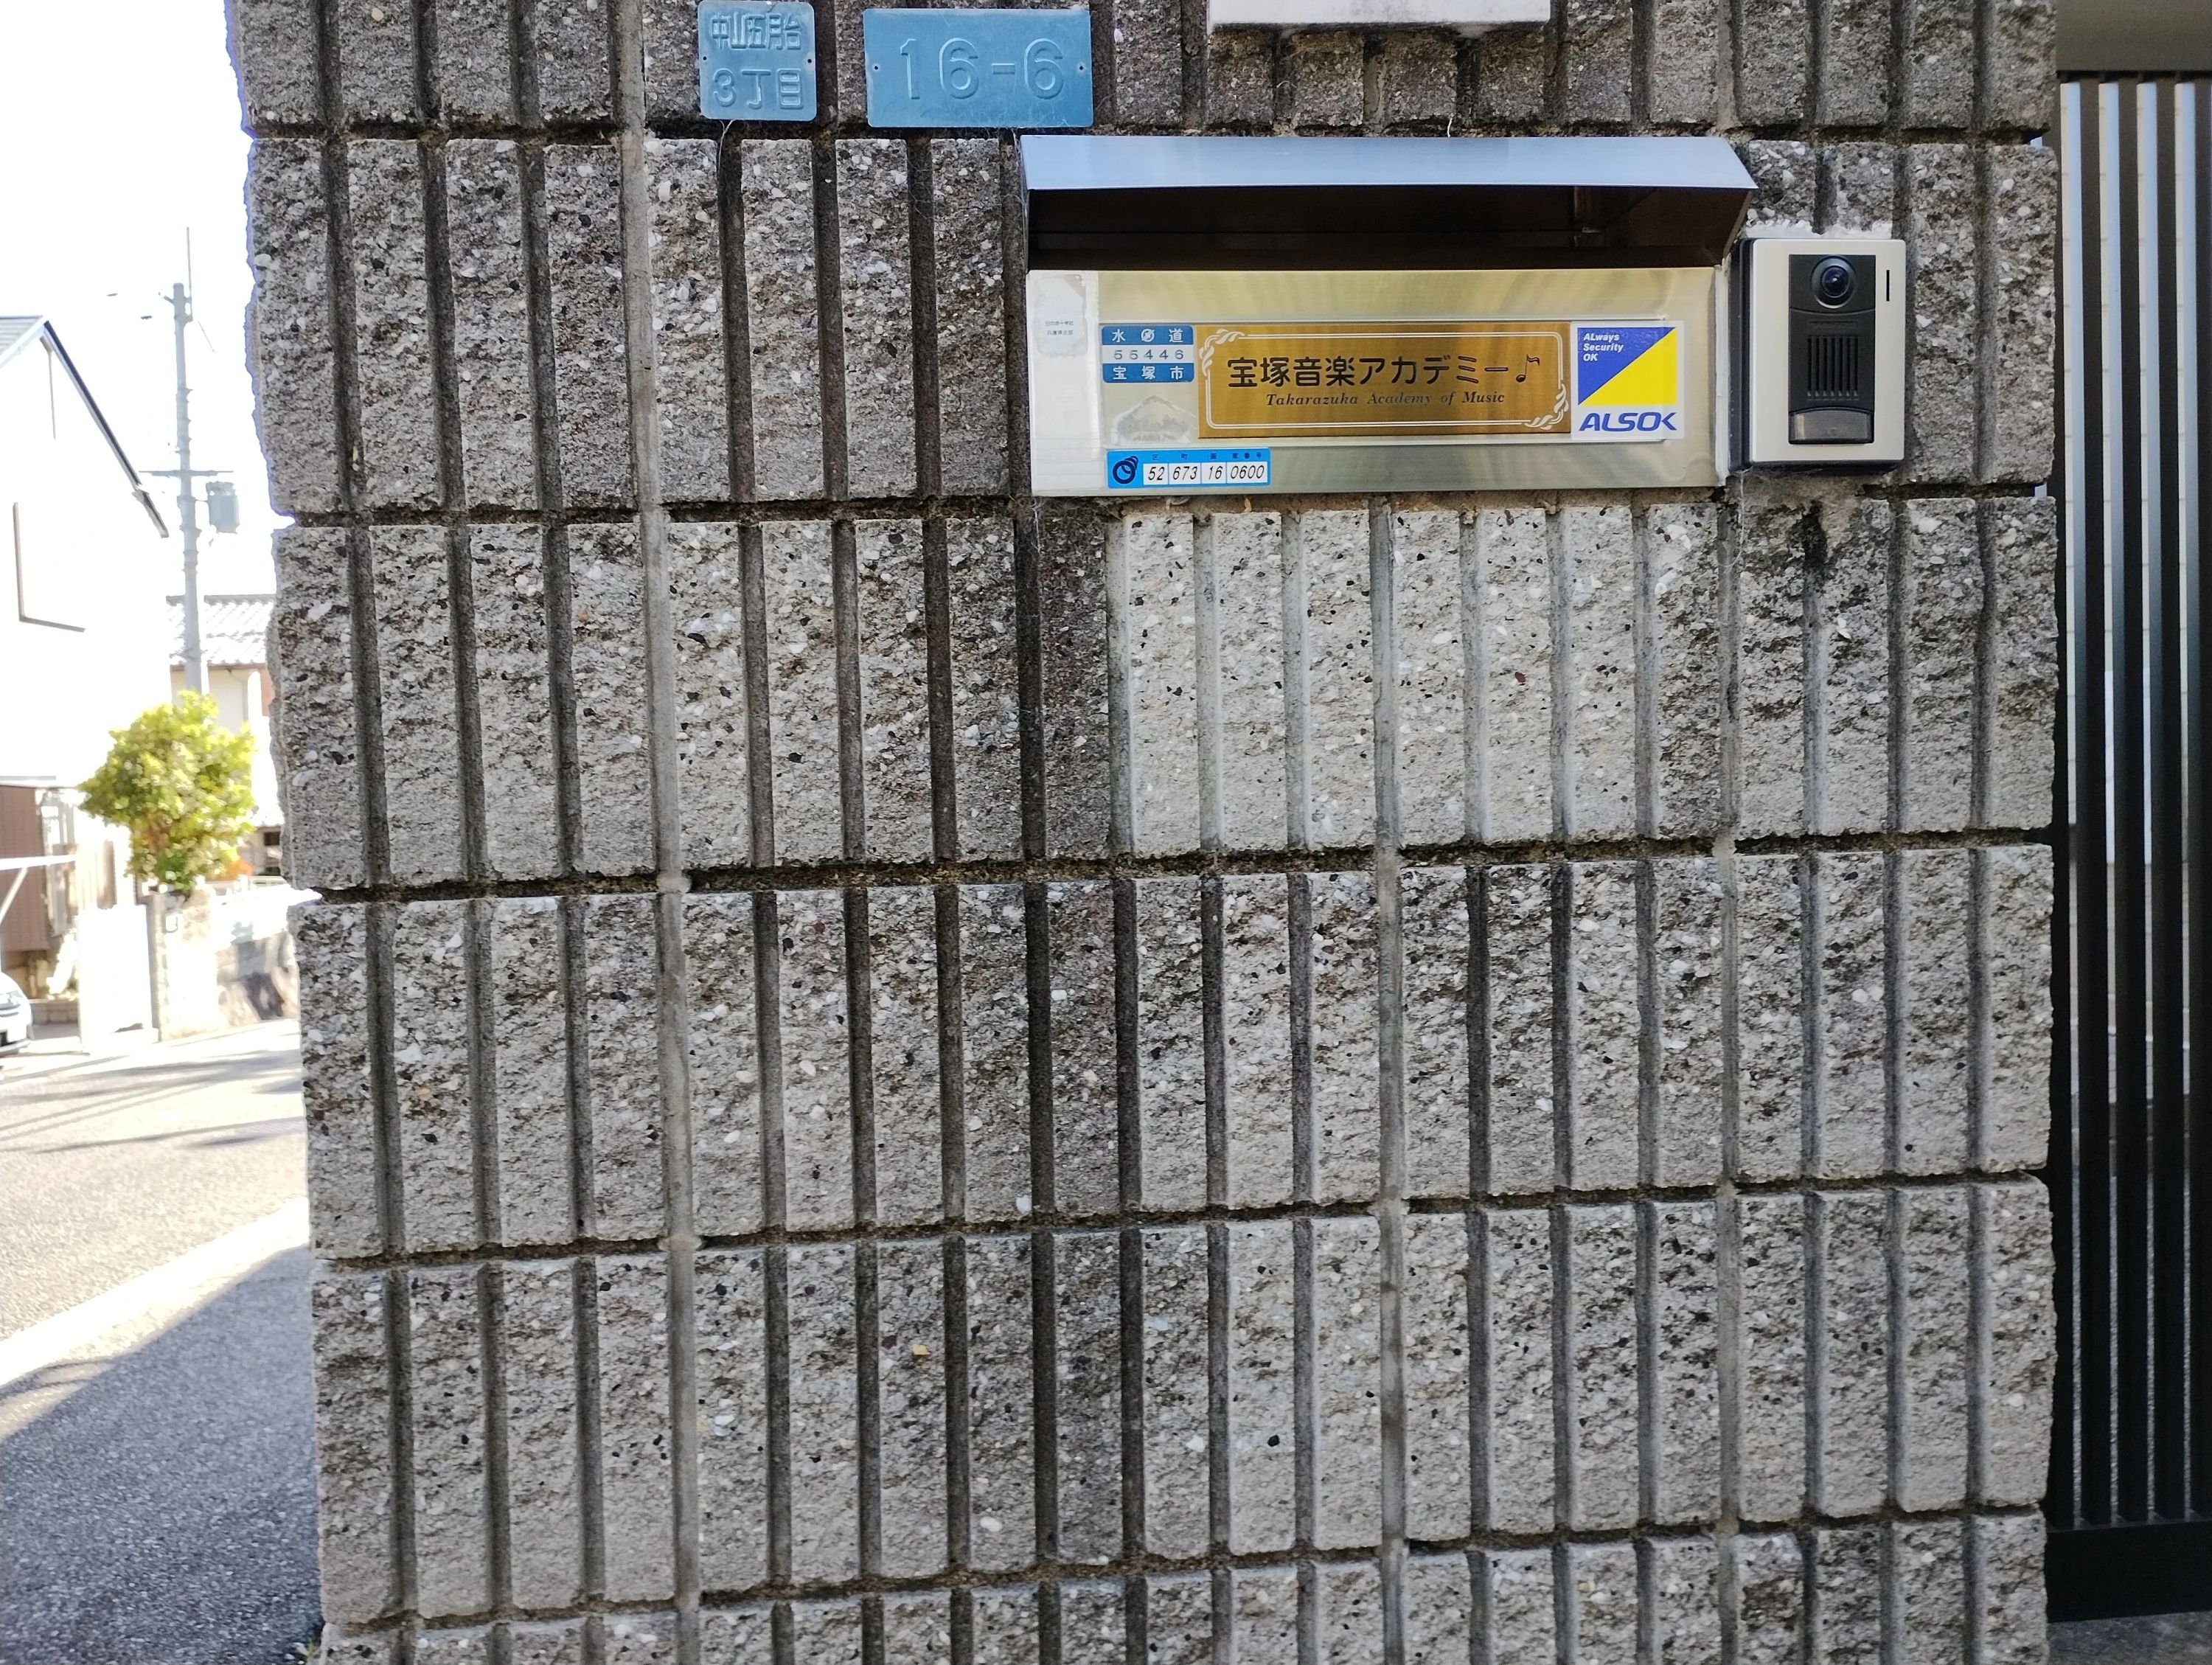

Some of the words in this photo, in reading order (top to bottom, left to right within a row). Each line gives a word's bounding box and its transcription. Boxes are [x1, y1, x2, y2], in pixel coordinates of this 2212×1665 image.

[710, 13, 801, 50] 中山五月台
[899, 38, 1065, 100] 16-6
[713, 68, 804, 110] 3丁目
[1583, 333, 1620, 343] ALways
[1113, 350, 1184, 360] 55446
[1583, 343, 1624, 352] Security
[1583, 353, 1599, 361] OK
[1113, 366, 1184, 380] 宝塚市
[1228, 356, 1509, 387] 宝塚音楽アカデミー
[1267, 394, 1358, 406] Takarazuka
[1367, 393, 1433, 406] Academy
[1441, 392, 1455, 405] of
[1462, 391, 1505, 403] Music
[1579, 411, 1677, 432] ALSOK
[1148, 466, 1165, 480] 52
[1172, 466, 1198, 480] 673
[1208, 465, 1223, 479] 16
[1230, 465, 1265, 479] 0600
